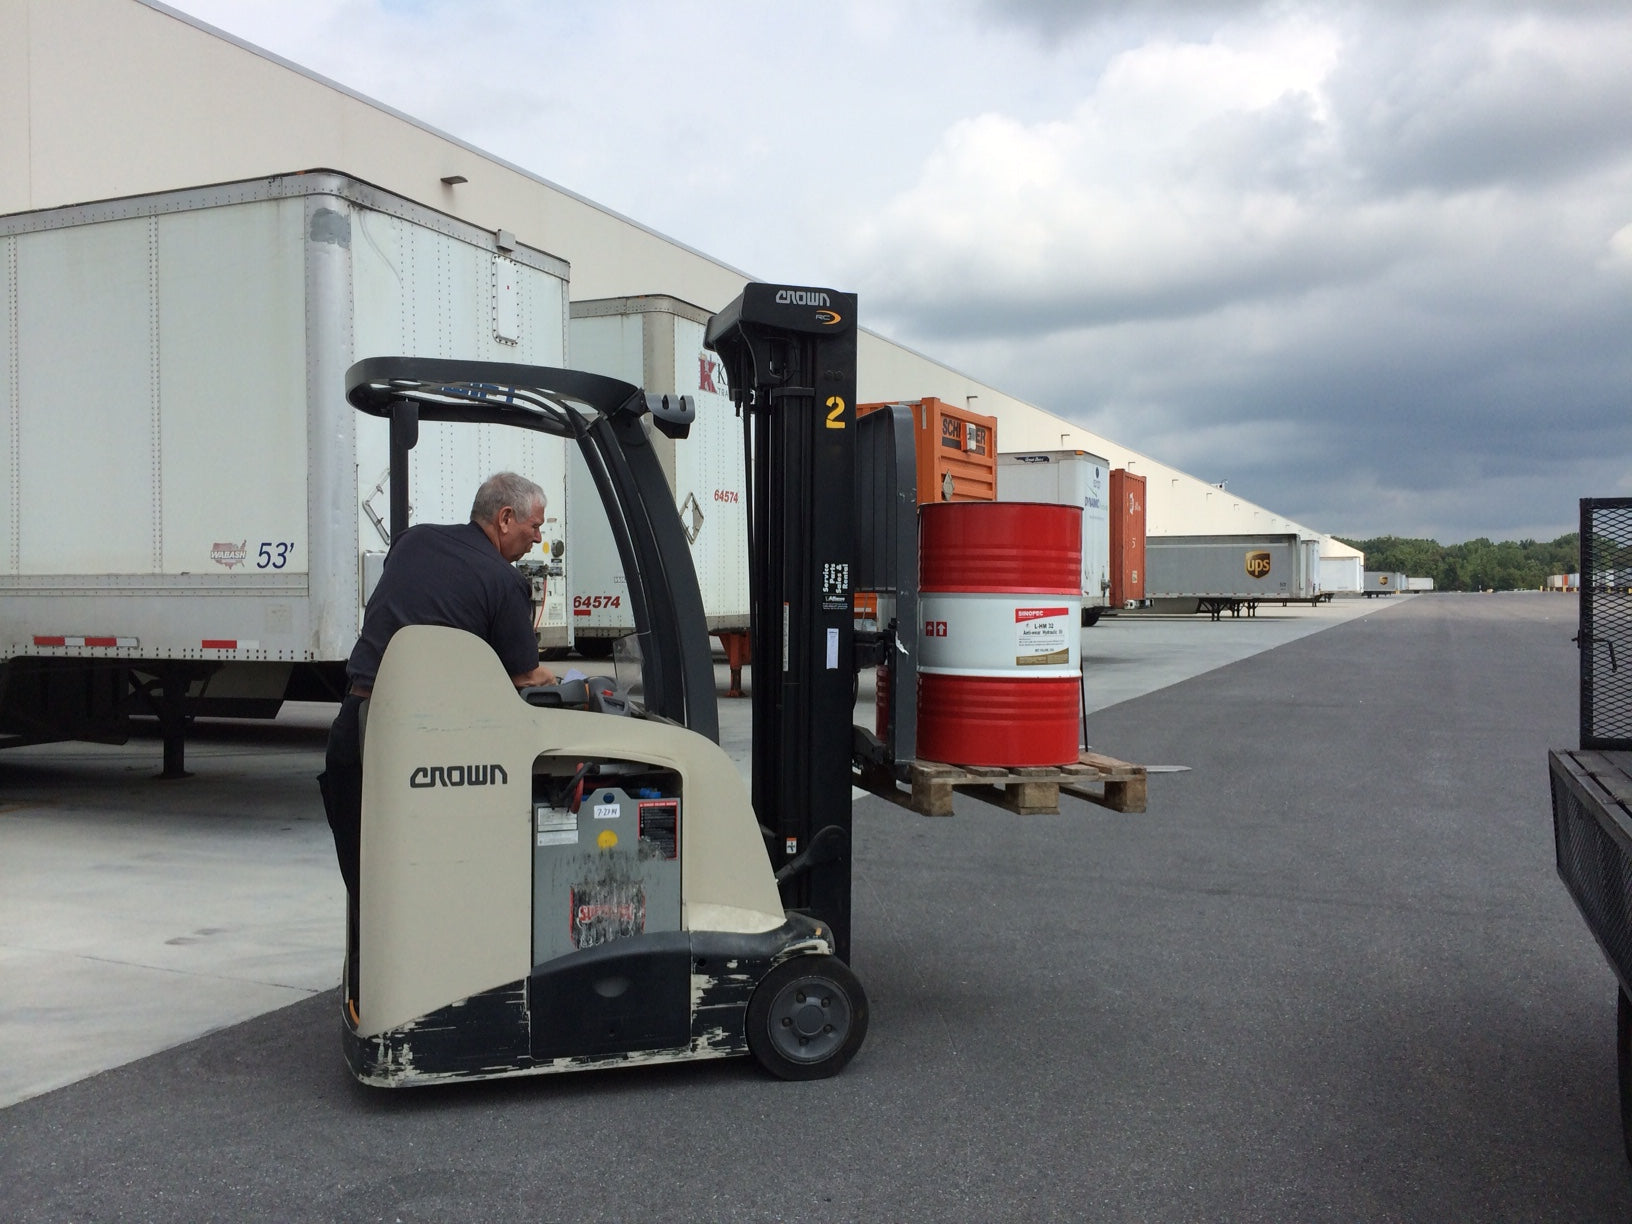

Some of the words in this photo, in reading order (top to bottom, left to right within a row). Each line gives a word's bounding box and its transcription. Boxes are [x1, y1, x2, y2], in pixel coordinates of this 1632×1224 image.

[775, 290, 830, 306] CROWN
[825, 396, 846, 429] 2
[714, 489, 738, 503] 64574
[211, 551, 246, 559] WABASH
[256, 542, 294, 569] 53'
[1247, 559, 1270, 576] ups
[573, 595, 621, 609] 64574
[410, 764, 507, 787] CROWN
